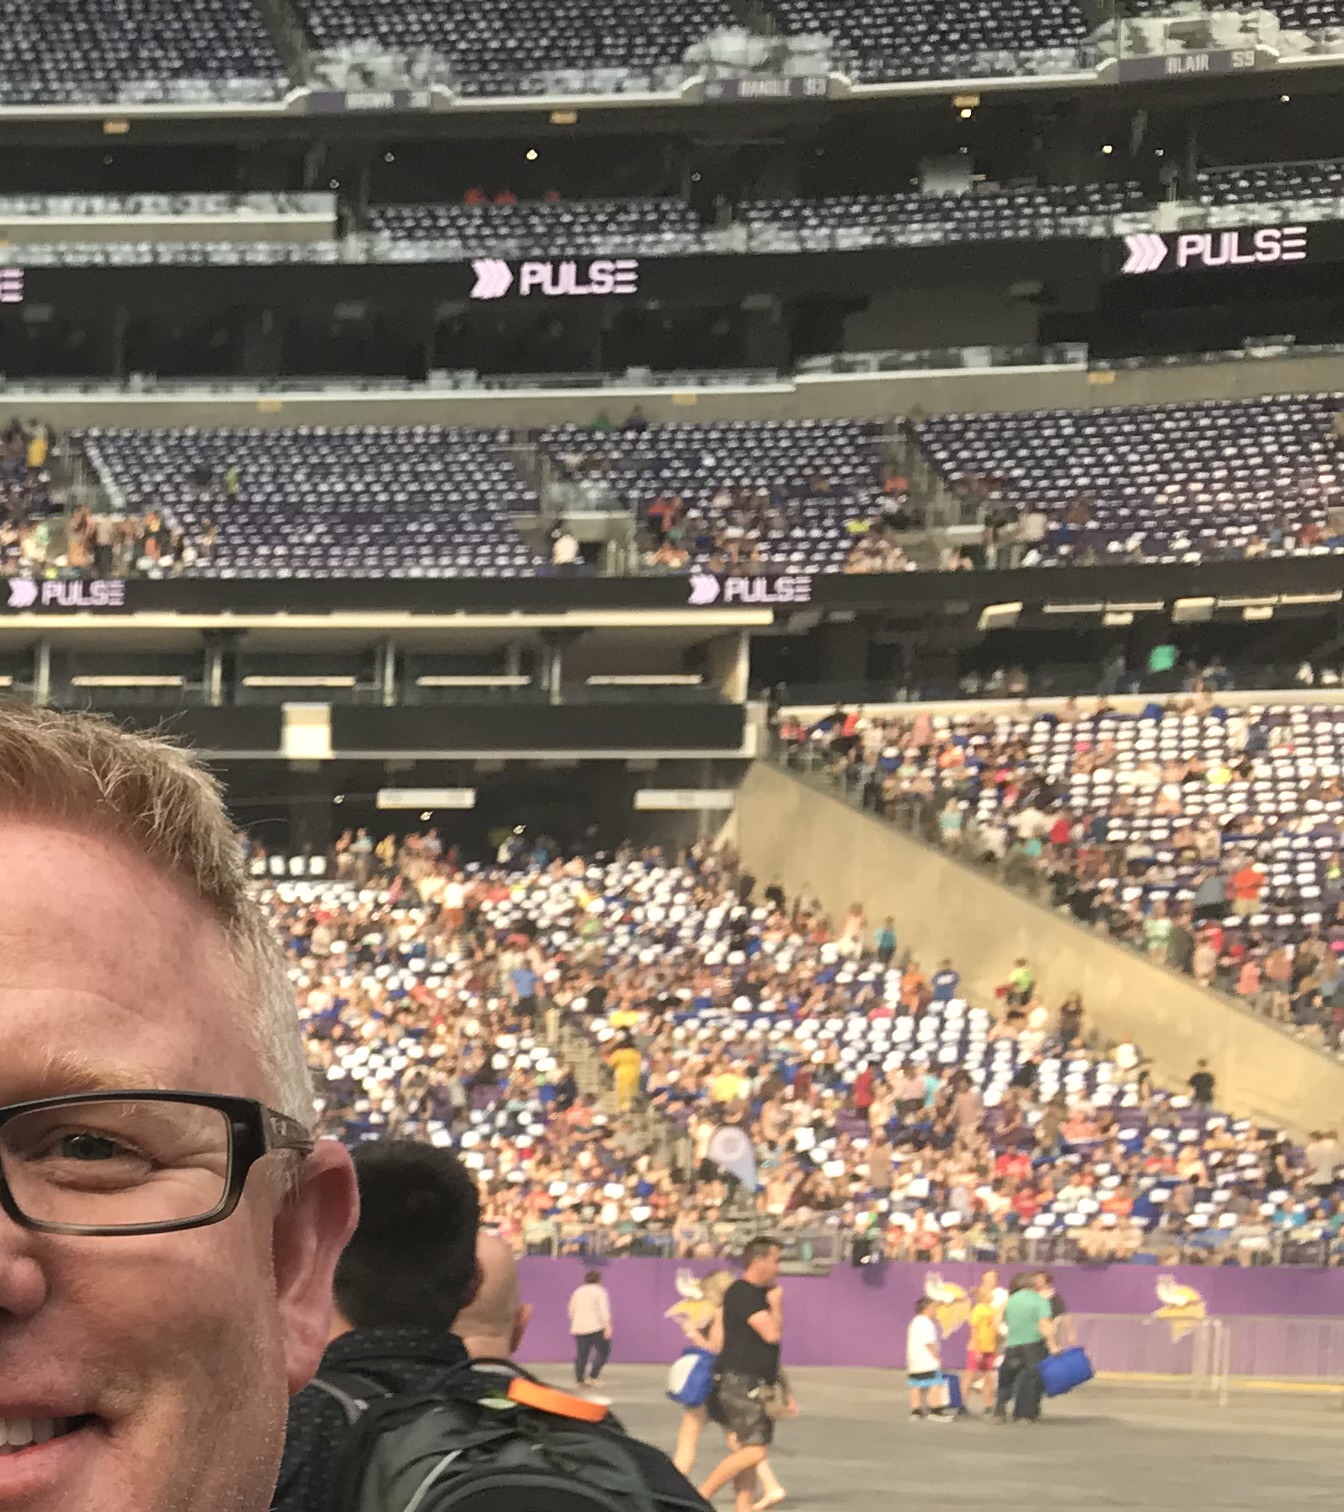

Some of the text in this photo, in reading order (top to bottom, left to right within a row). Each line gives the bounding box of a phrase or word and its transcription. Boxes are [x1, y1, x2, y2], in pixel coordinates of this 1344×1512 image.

[1165, 54, 1209, 74] BLAIR
[1177, 226, 1307, 268] PULSE
[520, 260, 639, 296] PULSE
[42, 579, 124, 606] PULSE
[724, 575, 812, 603] PULSE
